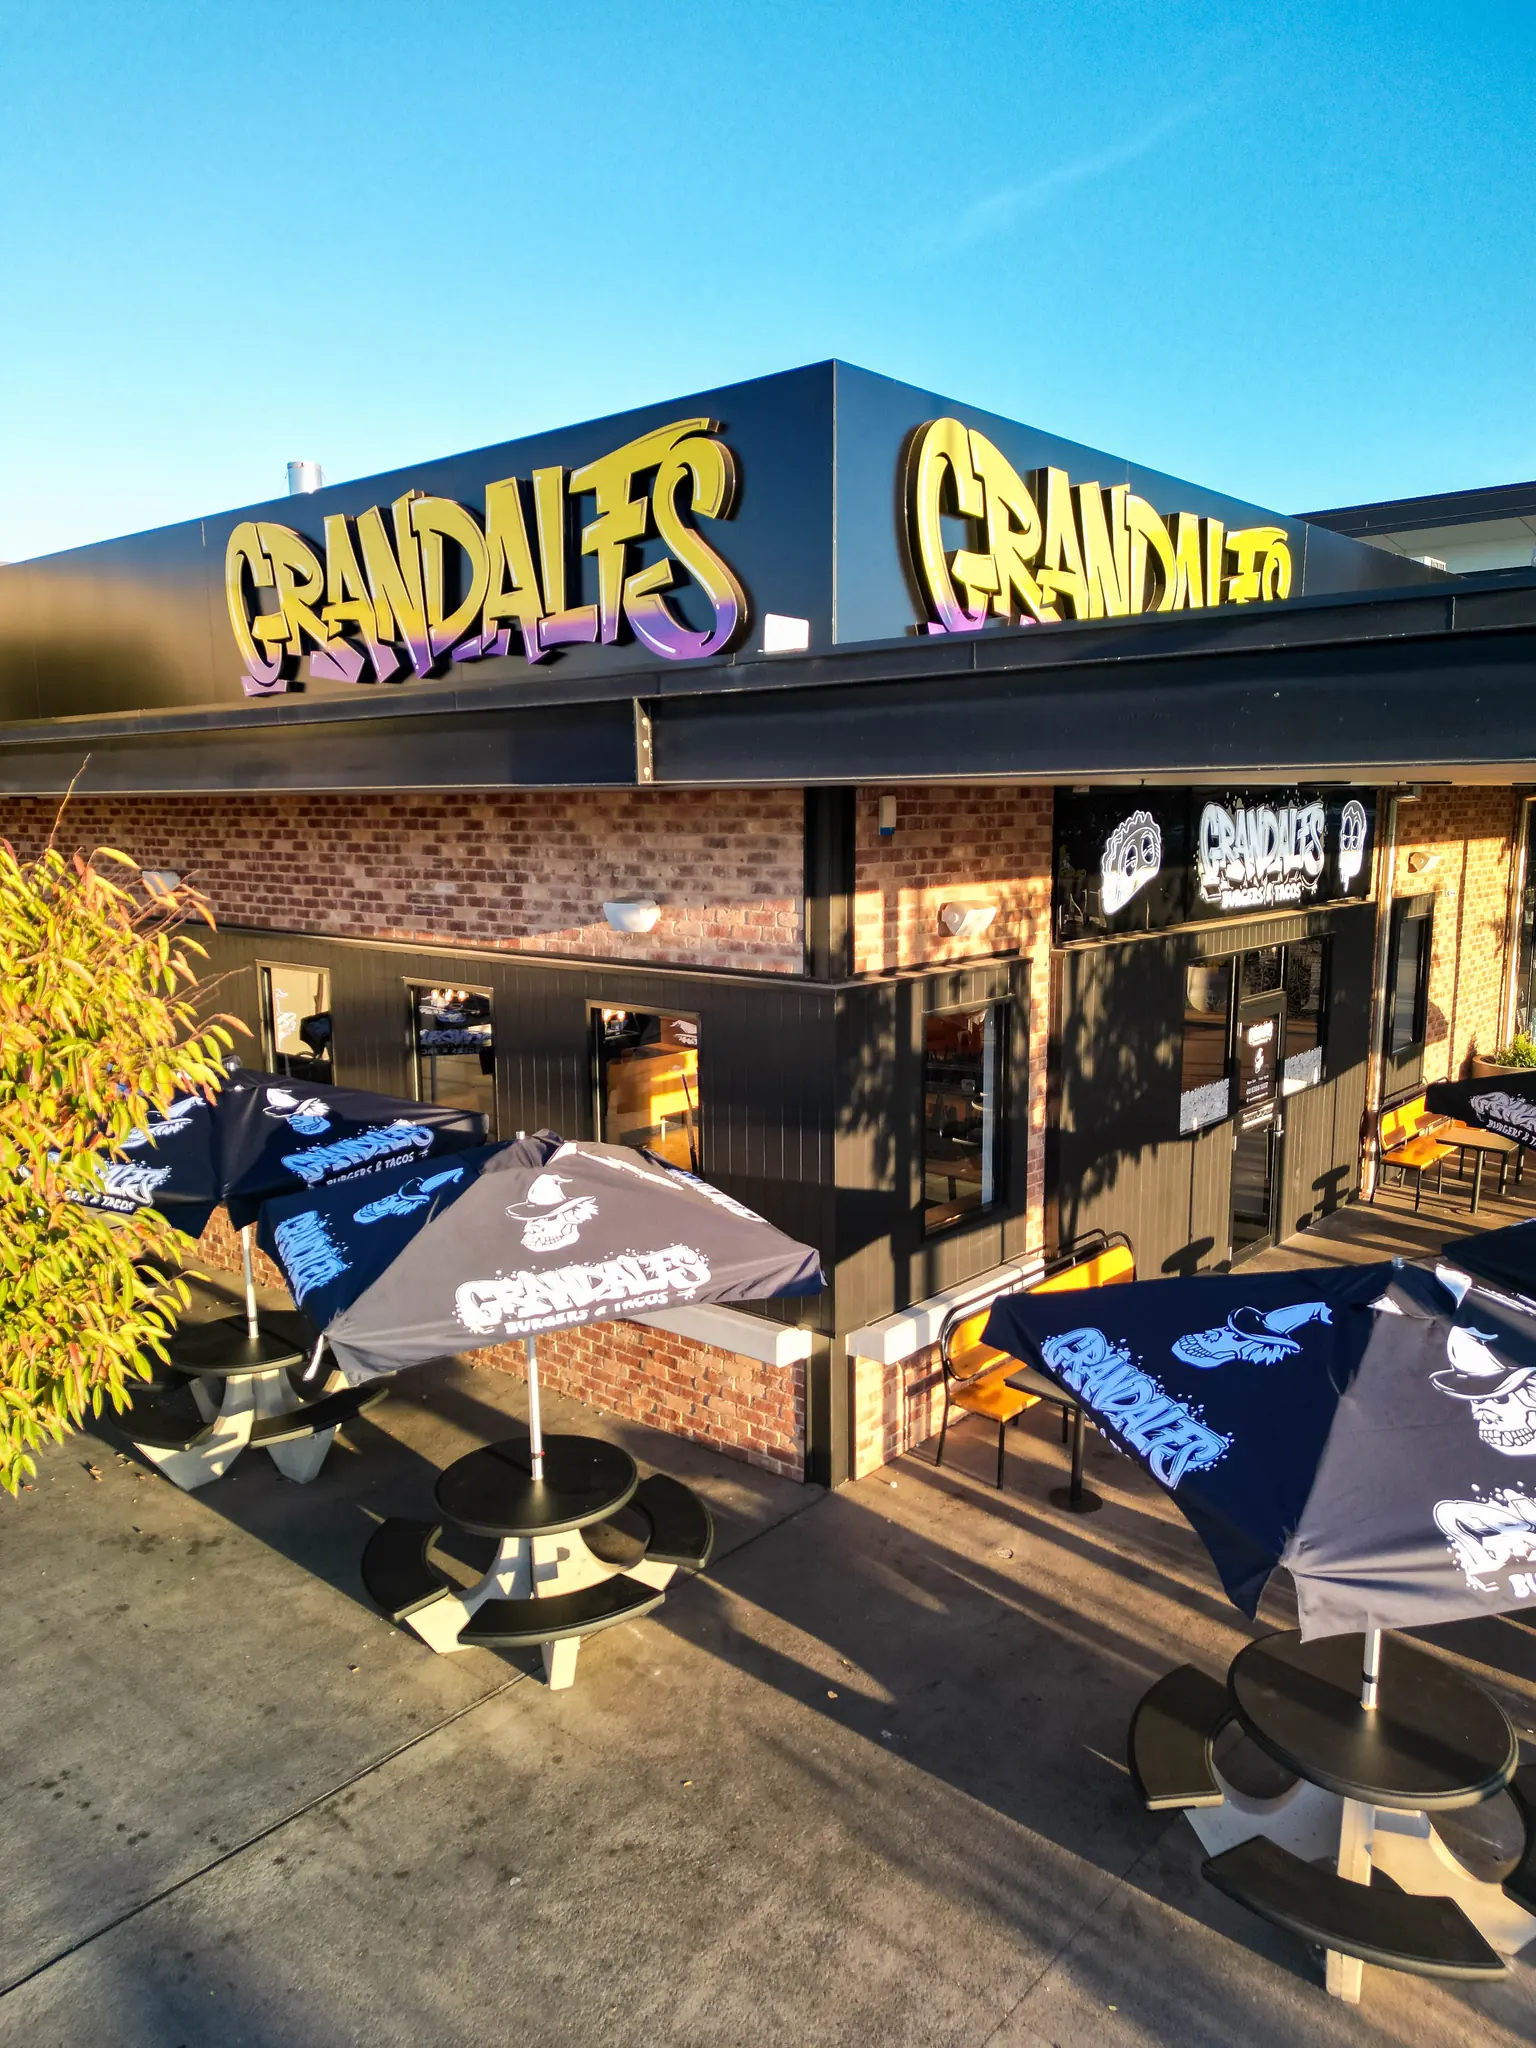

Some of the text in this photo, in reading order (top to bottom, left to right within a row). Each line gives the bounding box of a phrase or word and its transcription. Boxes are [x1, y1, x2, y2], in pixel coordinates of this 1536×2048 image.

[1199, 800, 1325, 902] GRANDALFS
[1486, 1119, 1522, 1138] BURGERS
[384, 1151, 415, 1169] TACOS
[101, 1195, 136, 1211] TACOS
[455, 1245, 711, 1333] GRANDALFS
[504, 1309, 589, 1334] BURGERS
[614, 1291, 669, 1312] TACOS
